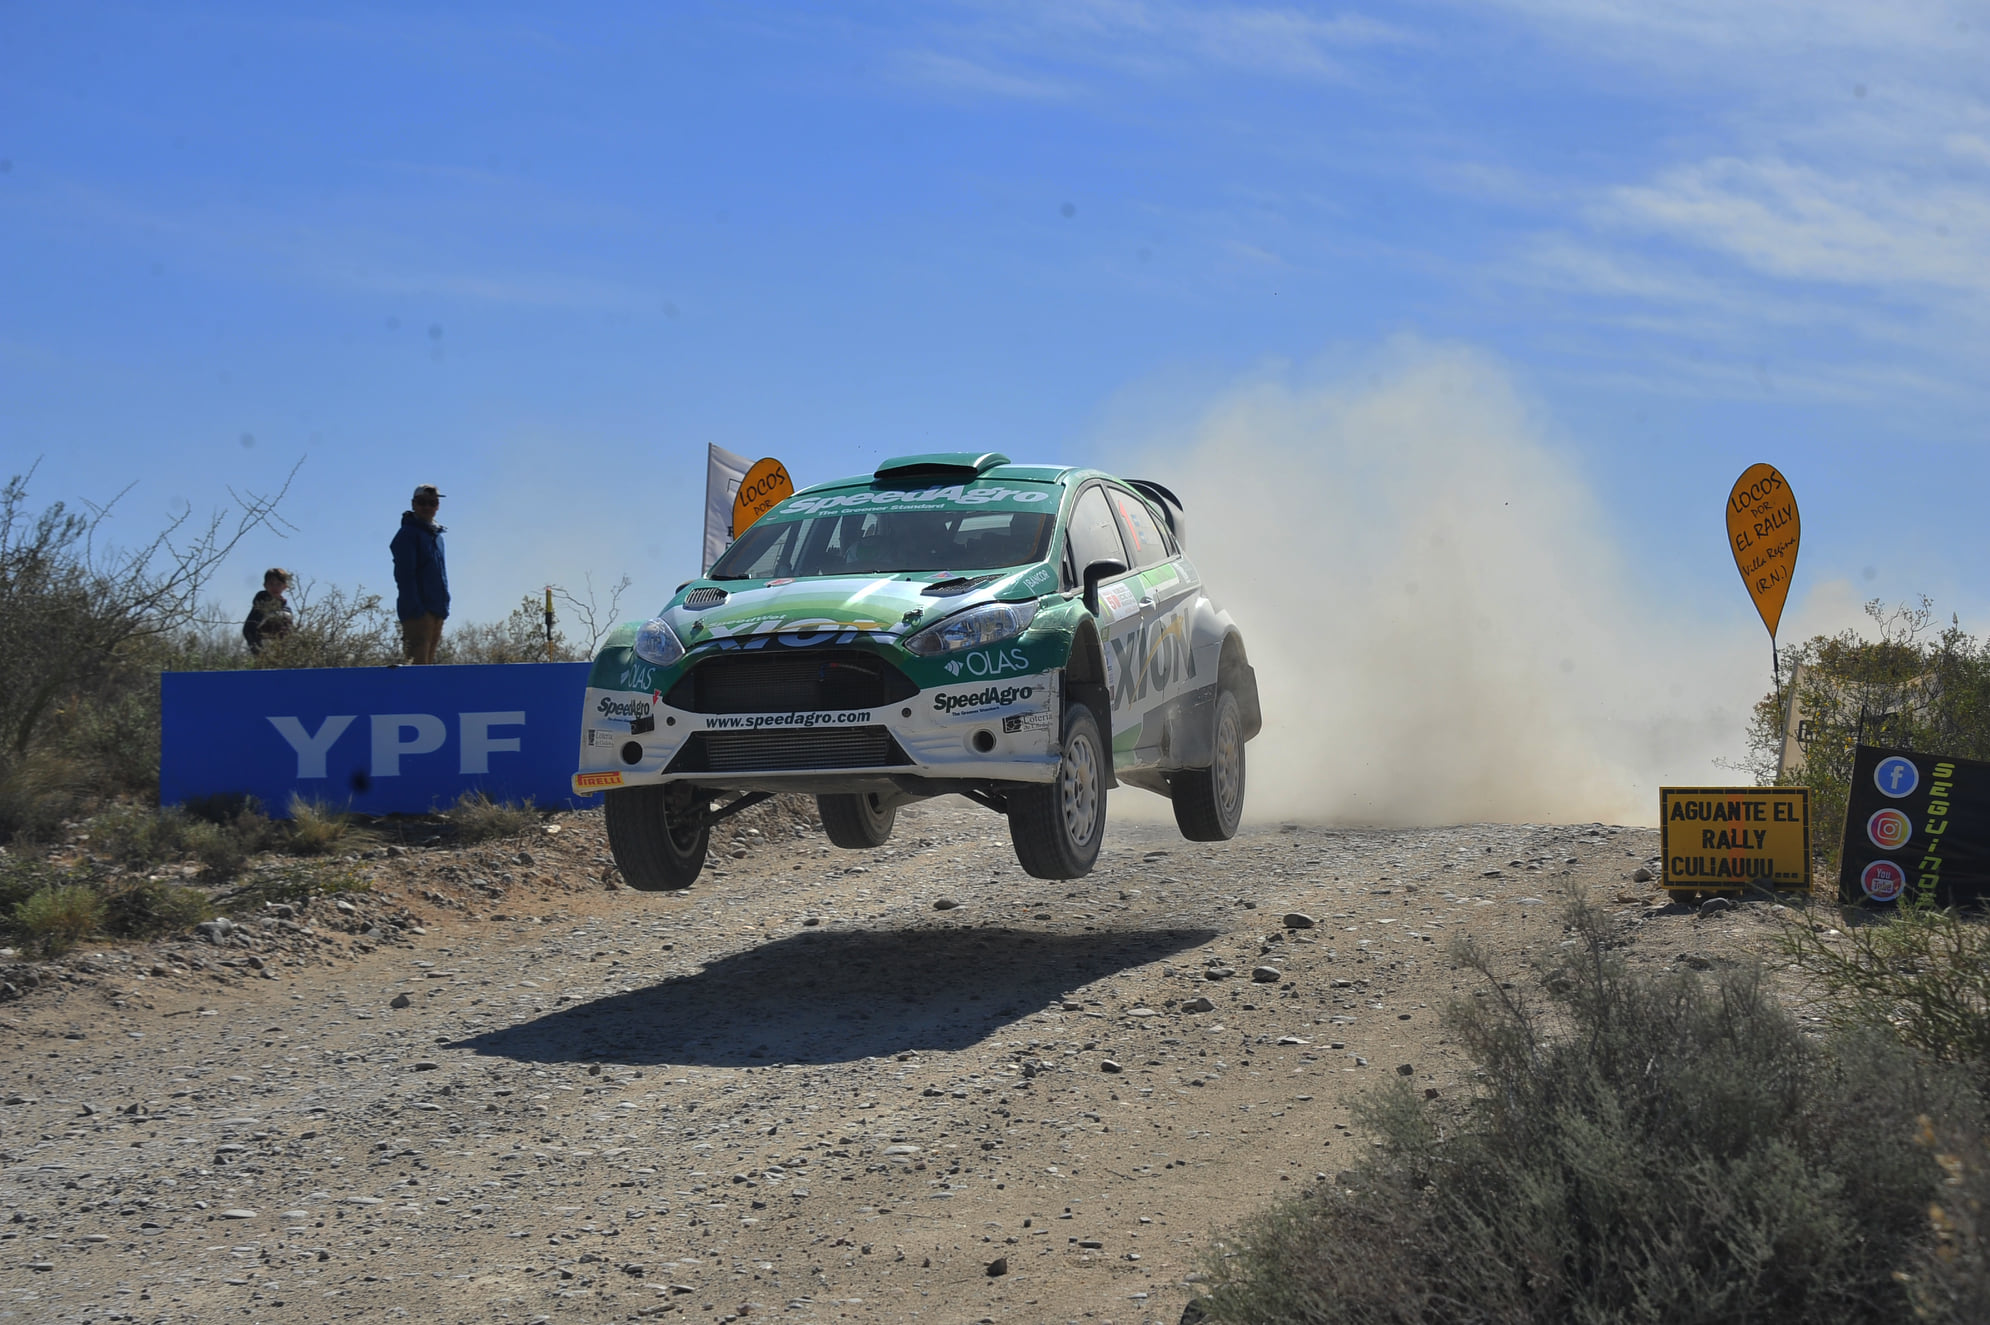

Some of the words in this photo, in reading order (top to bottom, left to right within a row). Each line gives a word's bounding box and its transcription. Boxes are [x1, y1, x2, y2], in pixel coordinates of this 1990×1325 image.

[740, 466, 786, 508] LOCOS
[780, 484, 1049, 515] SpeedAgro
[1731, 471, 1782, 514] LOCOS
[754, 500, 774, 516] POR
[841, 505, 888, 514] Greener
[890, 503, 945, 511] Standard
[1751, 501, 1773, 519] POR
[1735, 531, 1753, 553] EL
[1753, 503, 1793, 540] RALLY
[1742, 556, 1767, 578] Villa
[1766, 536, 1797, 560] Regina
[1755, 564, 1788, 595] (R.N.)
[966, 648, 1029, 676] OLAS
[627, 663, 656, 691] OLAS
[597, 697, 650, 719] SpeedAgro
[933, 686, 1033, 713] SpeedAgro
[706, 711, 871, 730] www.speedagro.com
[266, 710, 526, 779] YPF
[577, 771, 623, 786] PIRELLI
[1670, 800, 1767, 822] AGUANTE
[1774, 802, 1800, 822] EL
[1702, 829, 1767, 850] RALLY
[1876, 868, 1892, 879] You
